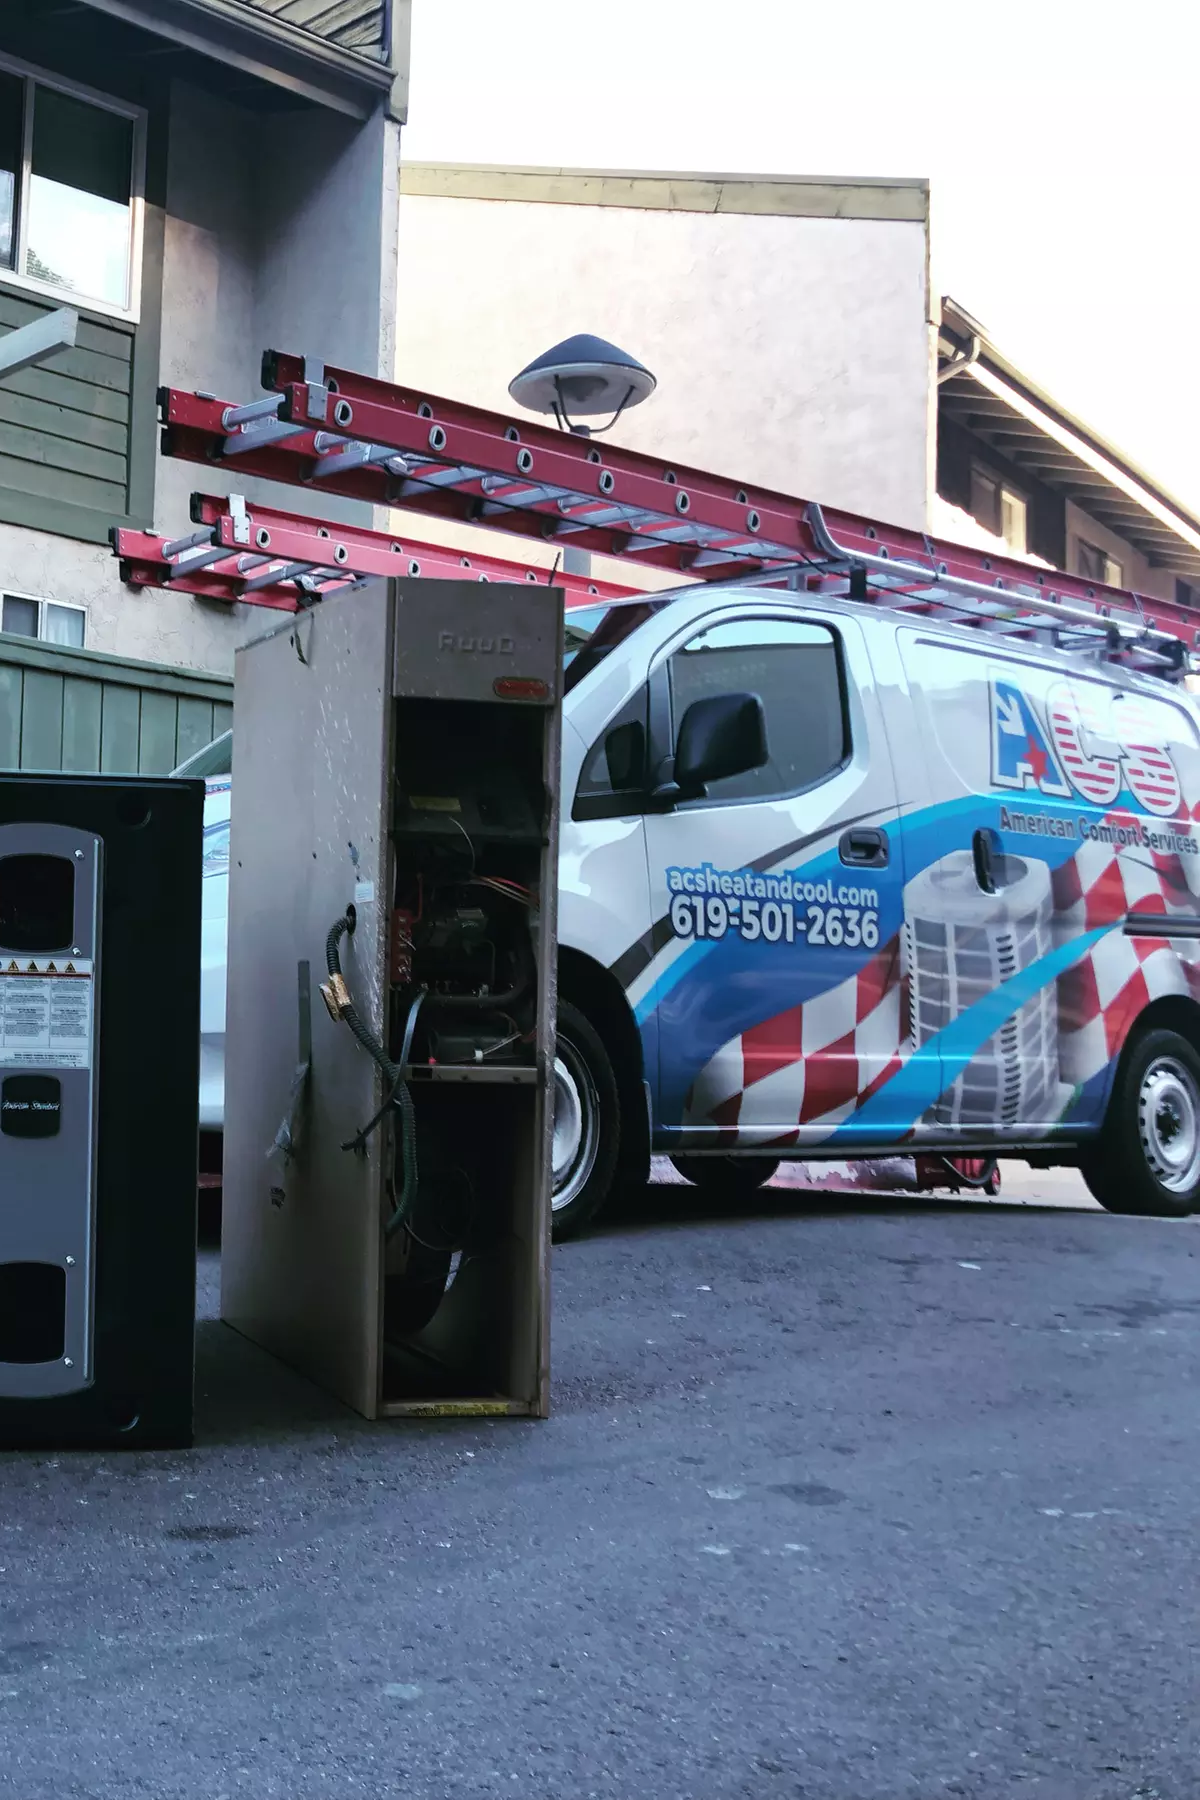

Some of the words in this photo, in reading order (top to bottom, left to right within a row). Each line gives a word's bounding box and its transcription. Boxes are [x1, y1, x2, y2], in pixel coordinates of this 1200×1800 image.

[1000, 806, 1078, 841] American
[1079, 815, 1139, 849] Comfort
[1141, 825, 1199, 856] Services
[669, 867, 879, 908] acsheatandcool.com
[671, 893, 880, 949] 619-501-2636
[2, 1100, 30, 1110] American
